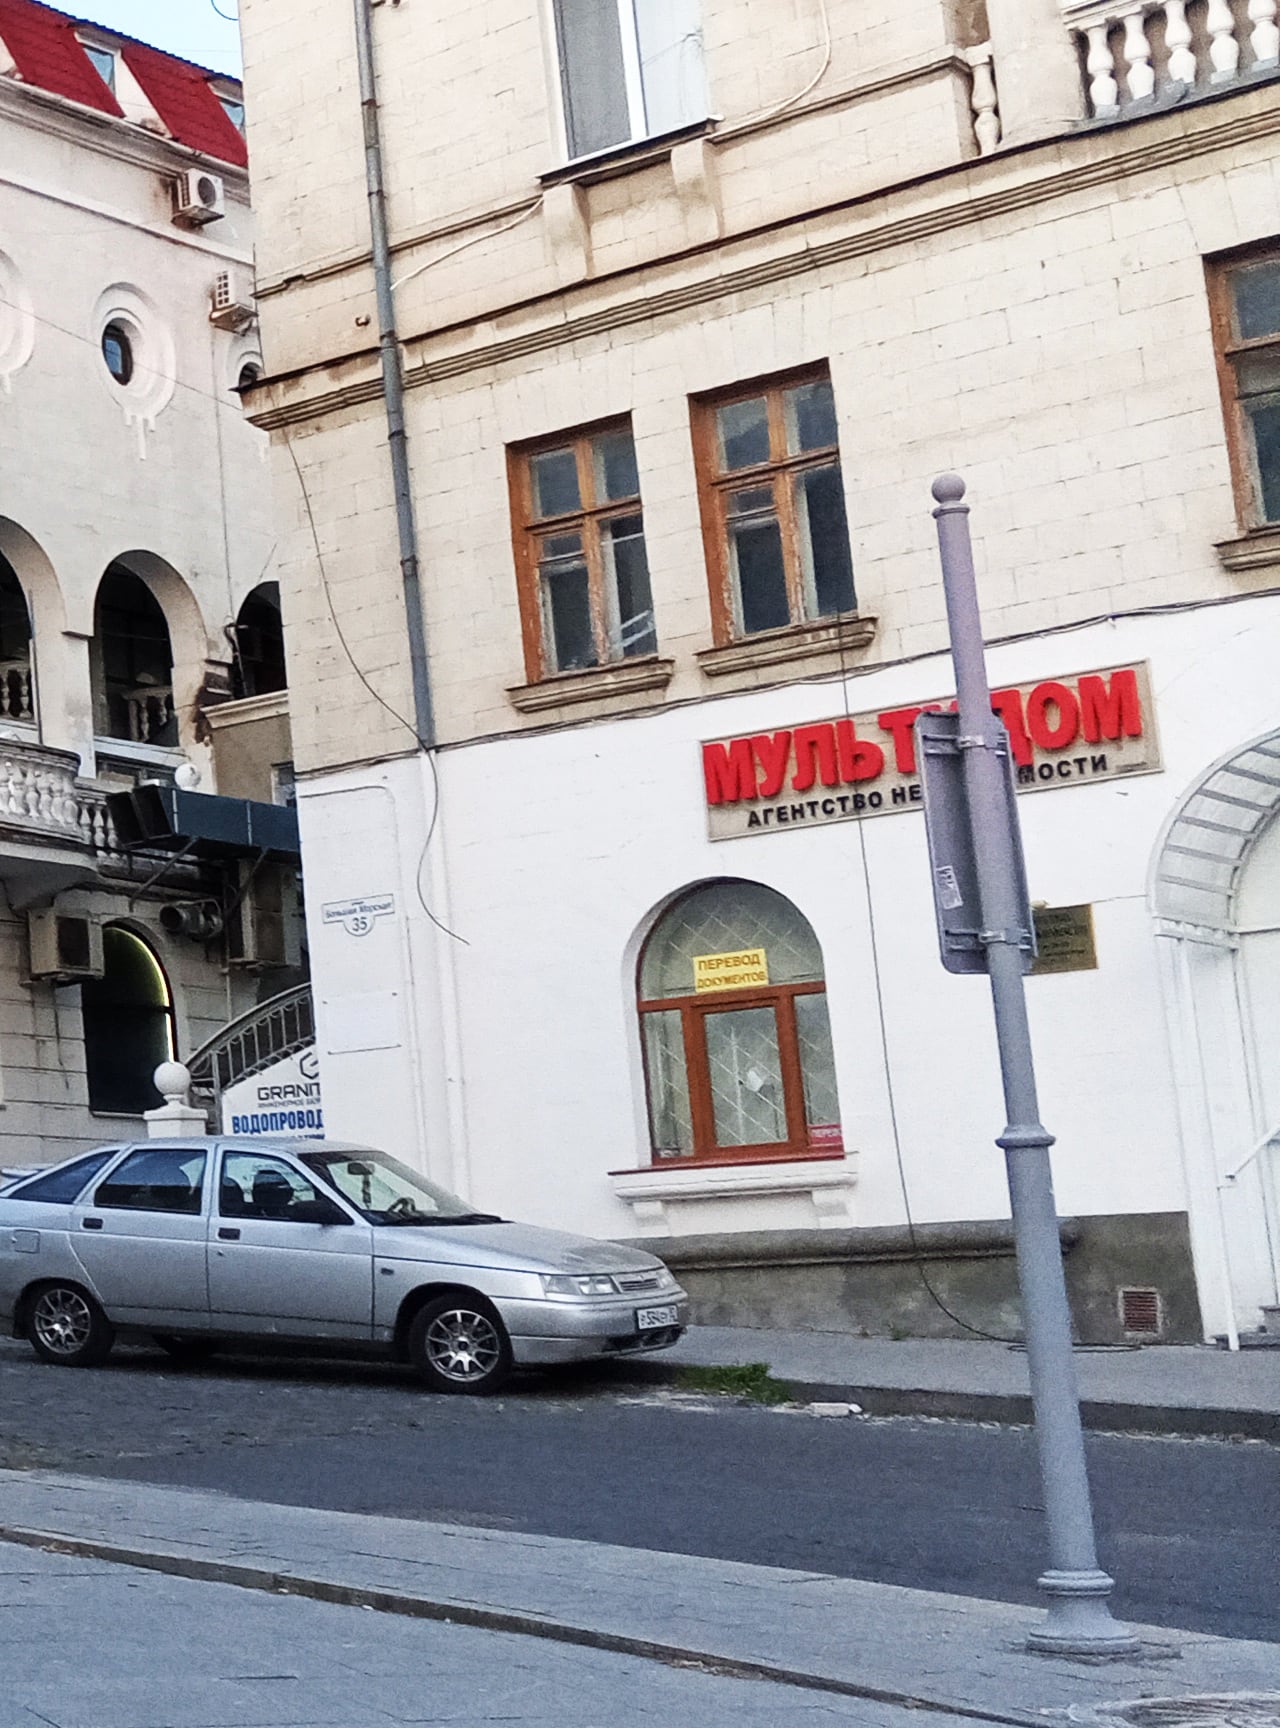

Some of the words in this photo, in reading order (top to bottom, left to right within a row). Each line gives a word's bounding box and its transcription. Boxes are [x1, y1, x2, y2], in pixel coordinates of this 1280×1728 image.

[702, 670, 1140, 804] МУЛЬТДОМ
[747, 790, 883, 829] АГЕНТСТВО
[351, 916, 368, 932] 35
[698, 953, 761, 971] ПЕРЕВОД
[697, 971, 765, 989] ДОКУМЕНТОВ
